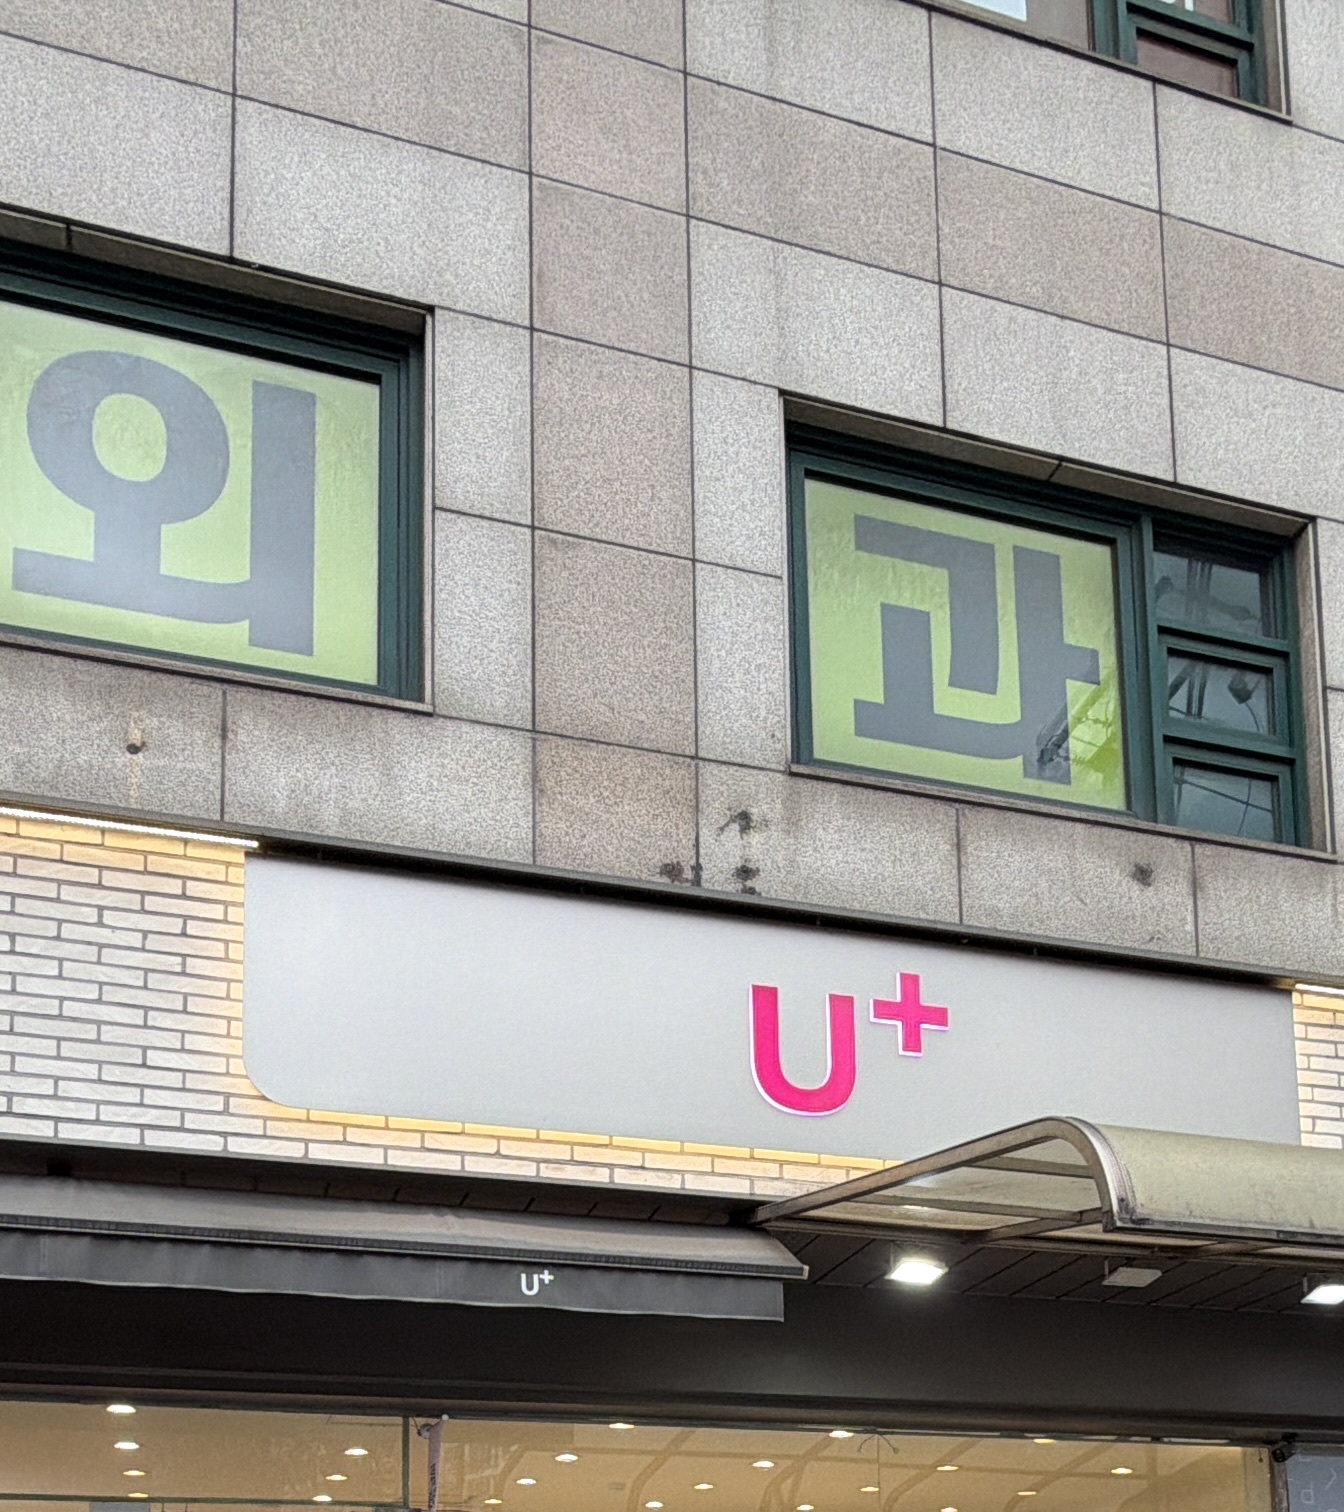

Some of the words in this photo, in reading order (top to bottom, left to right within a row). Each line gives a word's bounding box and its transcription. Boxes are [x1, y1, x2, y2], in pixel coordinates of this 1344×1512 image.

[12, 350, 317, 657] 외
[854, 515, 1101, 786] 과
[749, 971, 952, 1117] U+
[520, 1269, 554, 1296] U+
